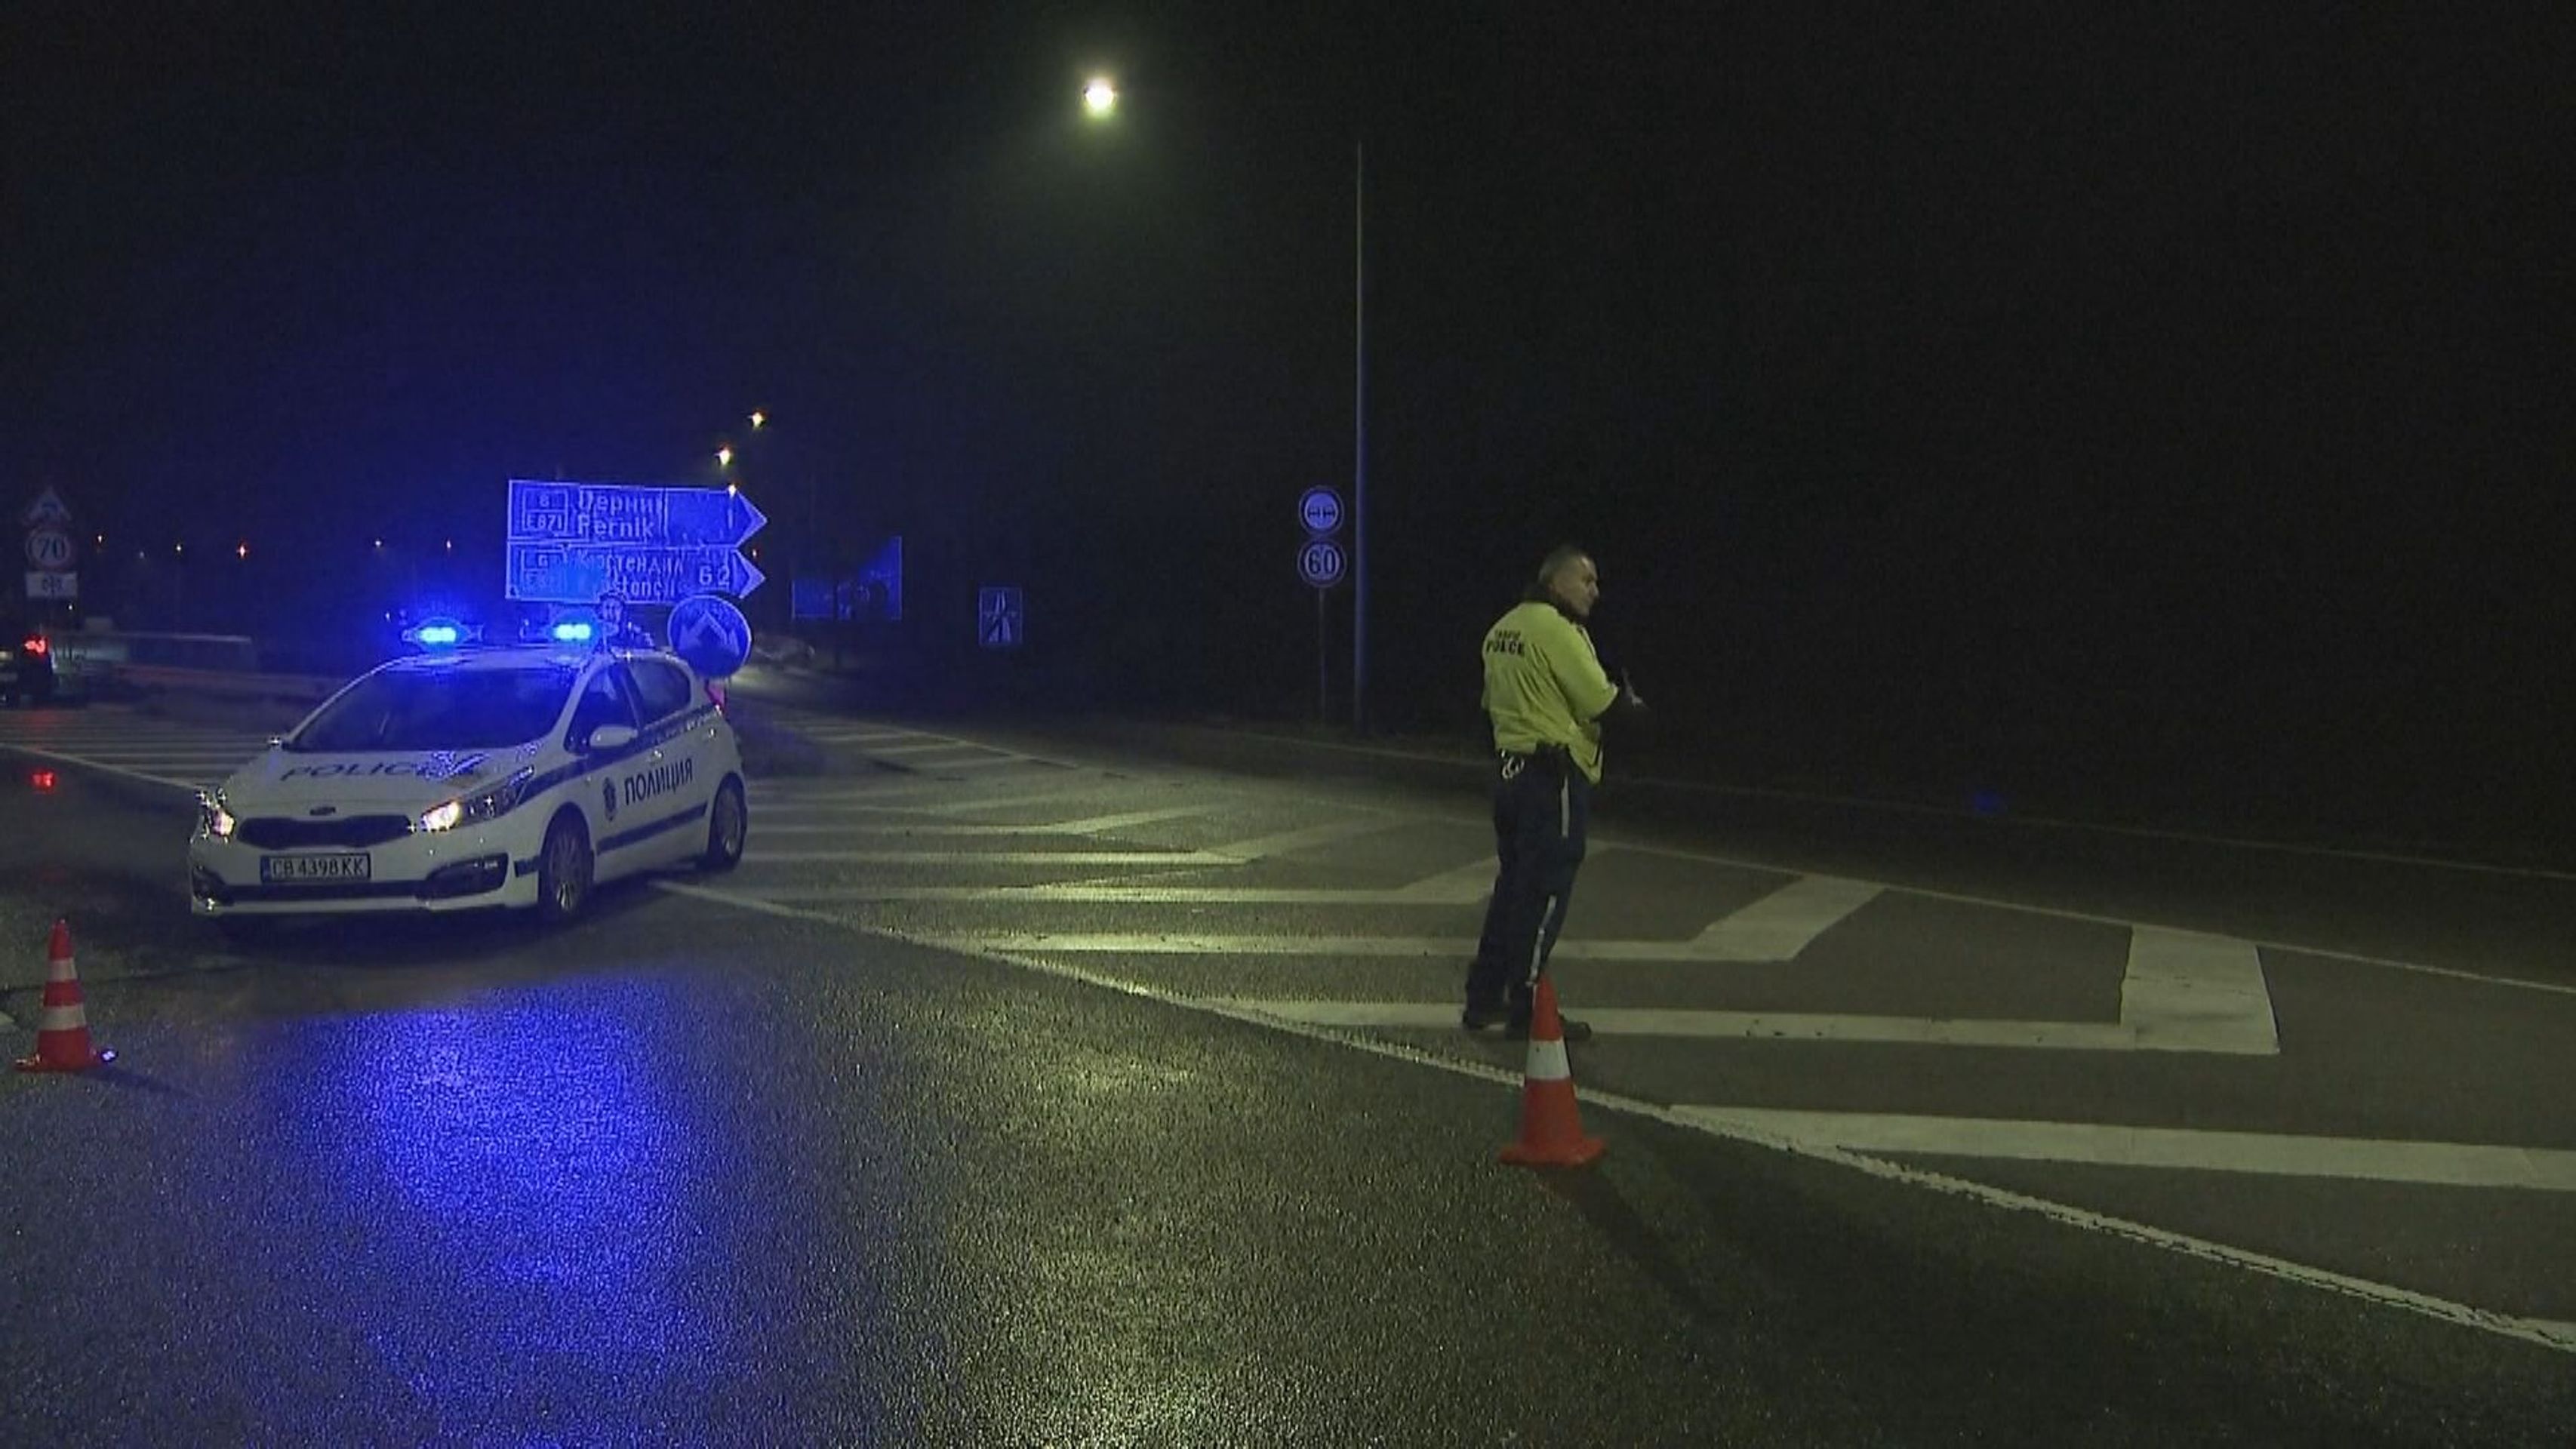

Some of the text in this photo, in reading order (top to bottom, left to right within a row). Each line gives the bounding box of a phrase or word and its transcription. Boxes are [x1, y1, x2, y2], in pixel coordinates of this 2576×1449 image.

[526, 514, 563, 530] E871
[577, 513, 654, 538] Pernik
[38, 537, 66, 558] 70
[1309, 549, 1336, 574] 60
[698, 565, 731, 586] 62
[279, 761, 436, 781] POLIC
[624, 758, 694, 805] ПОЛИЦИЯ
